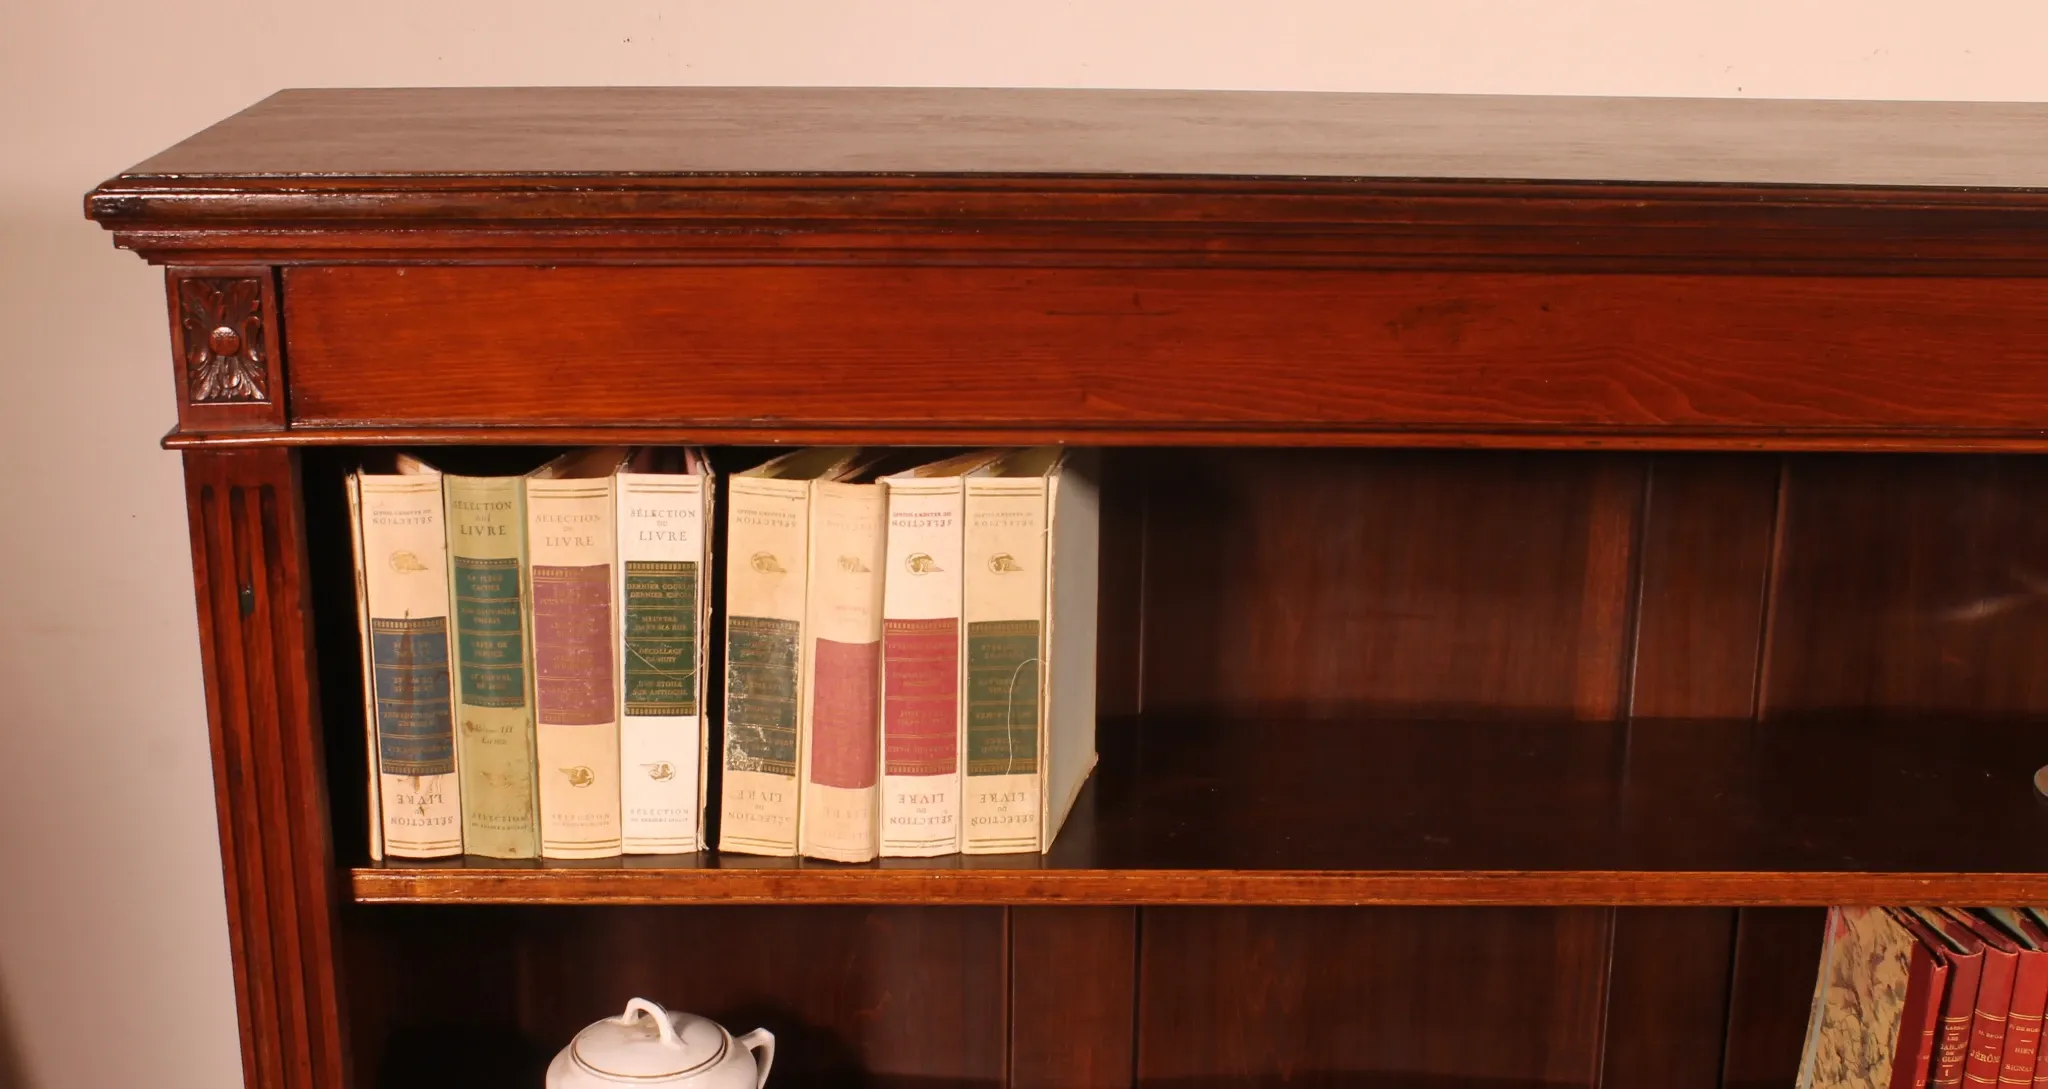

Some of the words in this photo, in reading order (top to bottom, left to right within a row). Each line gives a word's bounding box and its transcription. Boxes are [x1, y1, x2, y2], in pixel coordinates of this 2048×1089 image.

[460, 525, 507, 536] LIVRE
[639, 531, 687, 541] LIVRE
[545, 536, 595, 547] LIVRE
[736, 790, 783, 803] LIVRE
[897, 793, 945, 804] LIVRE
[979, 791, 1025, 803] LIVRE
[390, 815, 454, 827] SÉLECTION
[889, 814, 953, 826] SÉLECTION
[970, 814, 1035, 827] SÉLECTION
